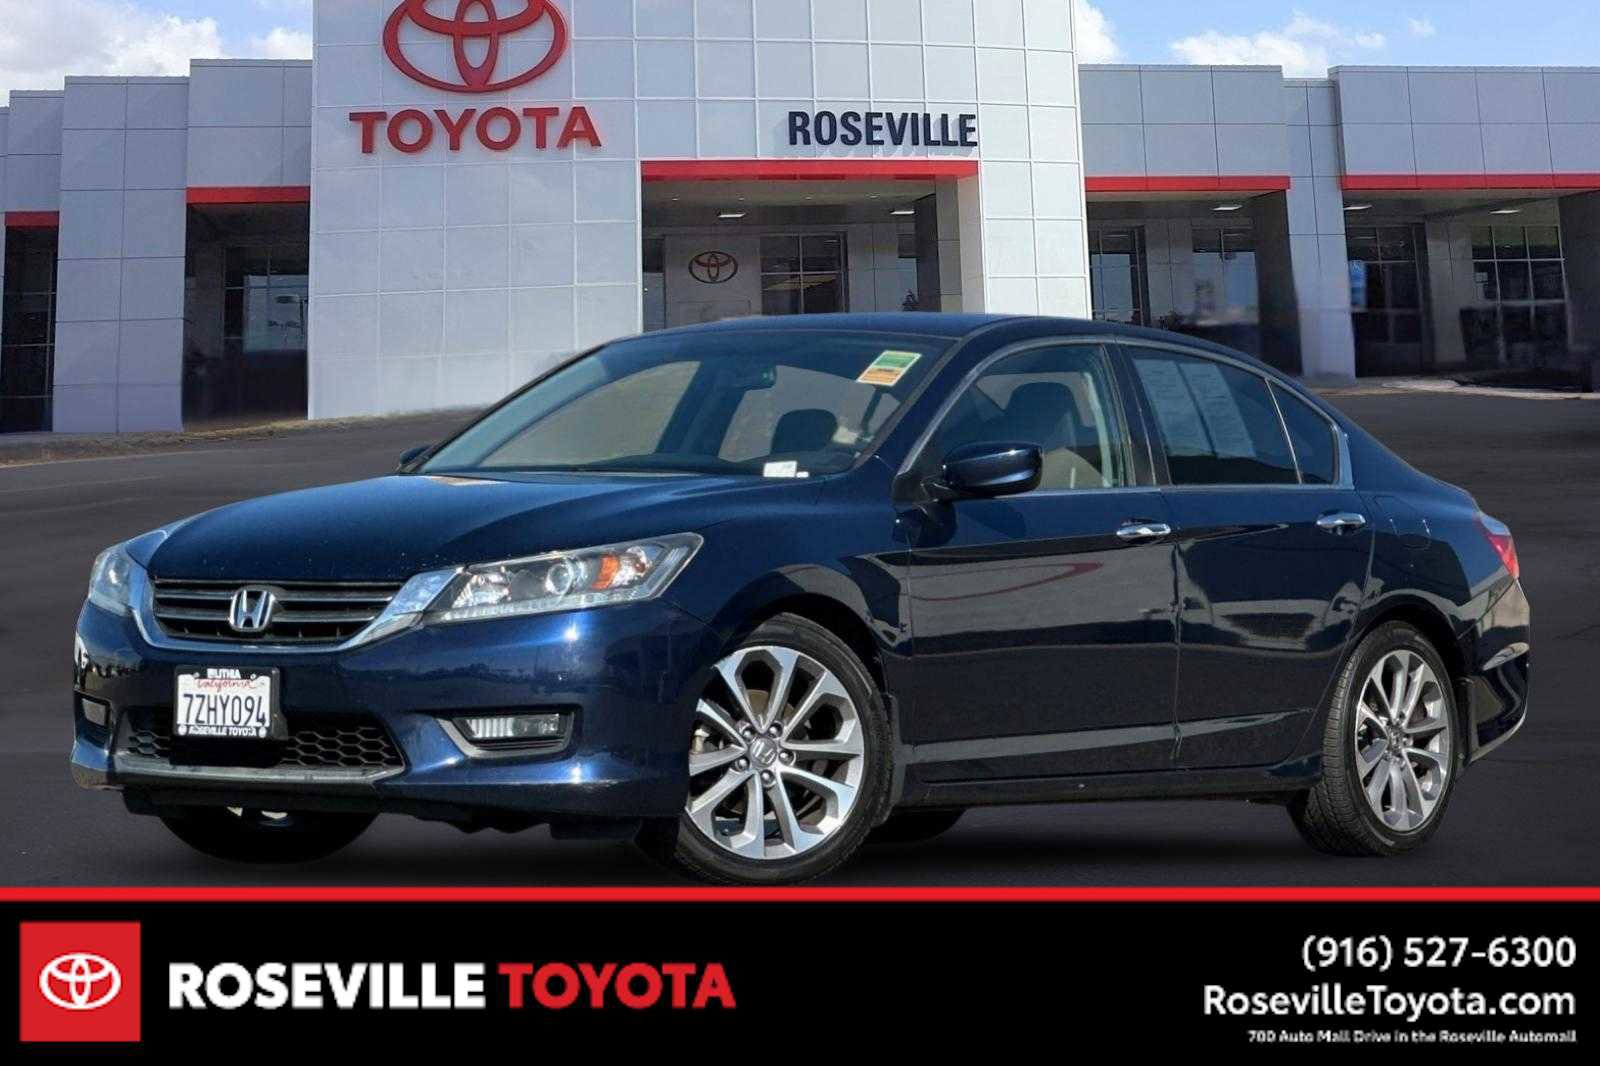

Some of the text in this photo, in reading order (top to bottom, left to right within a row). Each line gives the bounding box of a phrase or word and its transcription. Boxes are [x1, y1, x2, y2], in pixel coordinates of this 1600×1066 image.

[349, 106, 602, 154] TOYOTA
[788, 111, 978, 147] ROSEVILLE
[183, 693, 267, 726] 7ZHY094
